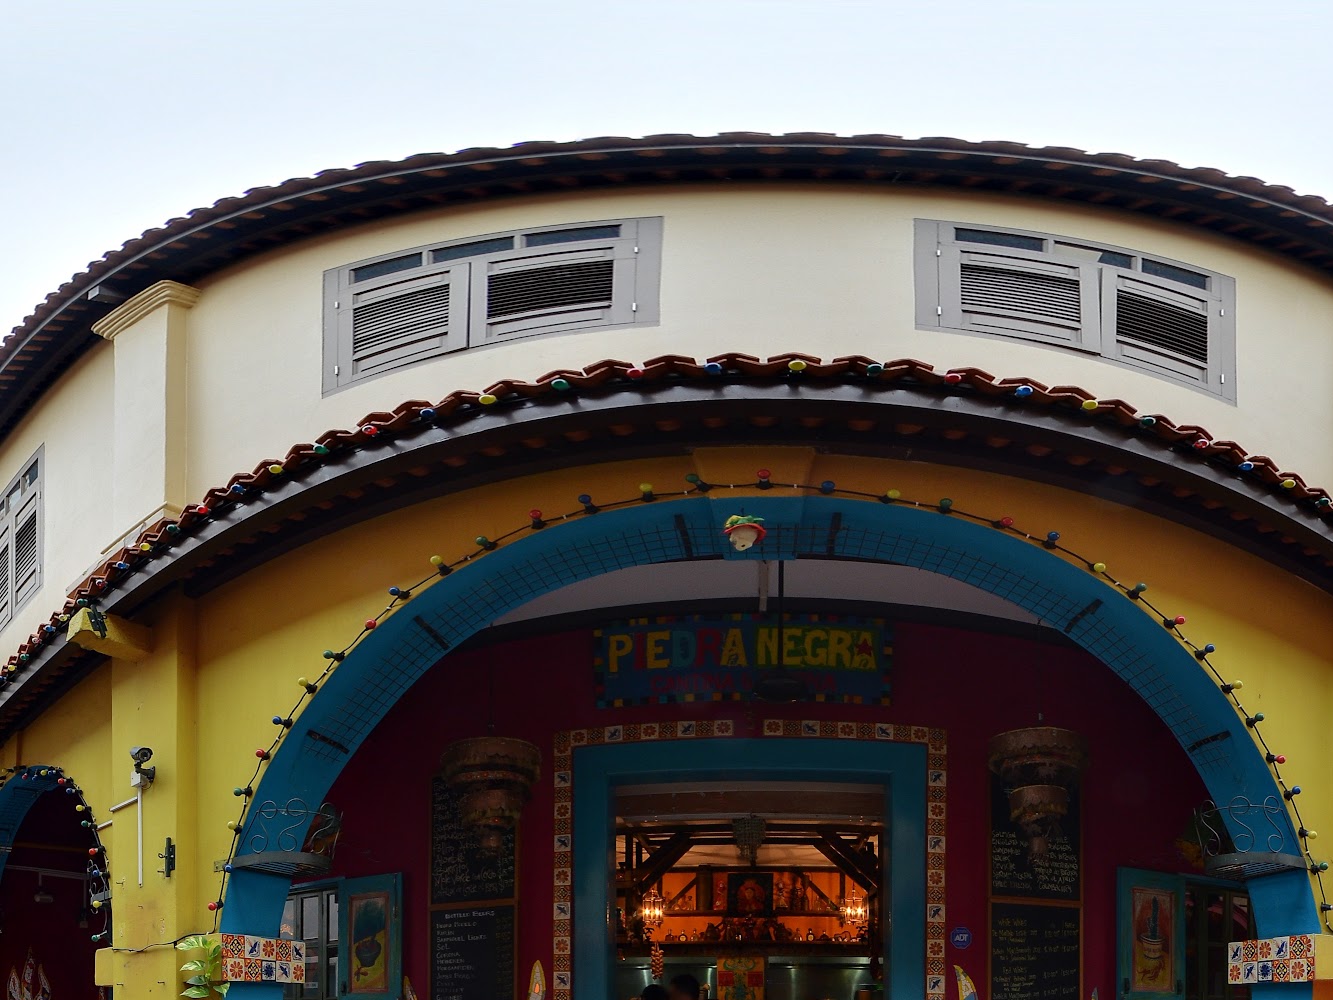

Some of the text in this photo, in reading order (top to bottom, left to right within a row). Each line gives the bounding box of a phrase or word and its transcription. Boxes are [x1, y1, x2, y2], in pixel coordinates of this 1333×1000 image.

[609, 627, 878, 673] PIEDRA NEGRA
[954, 933, 969, 942] ADT
